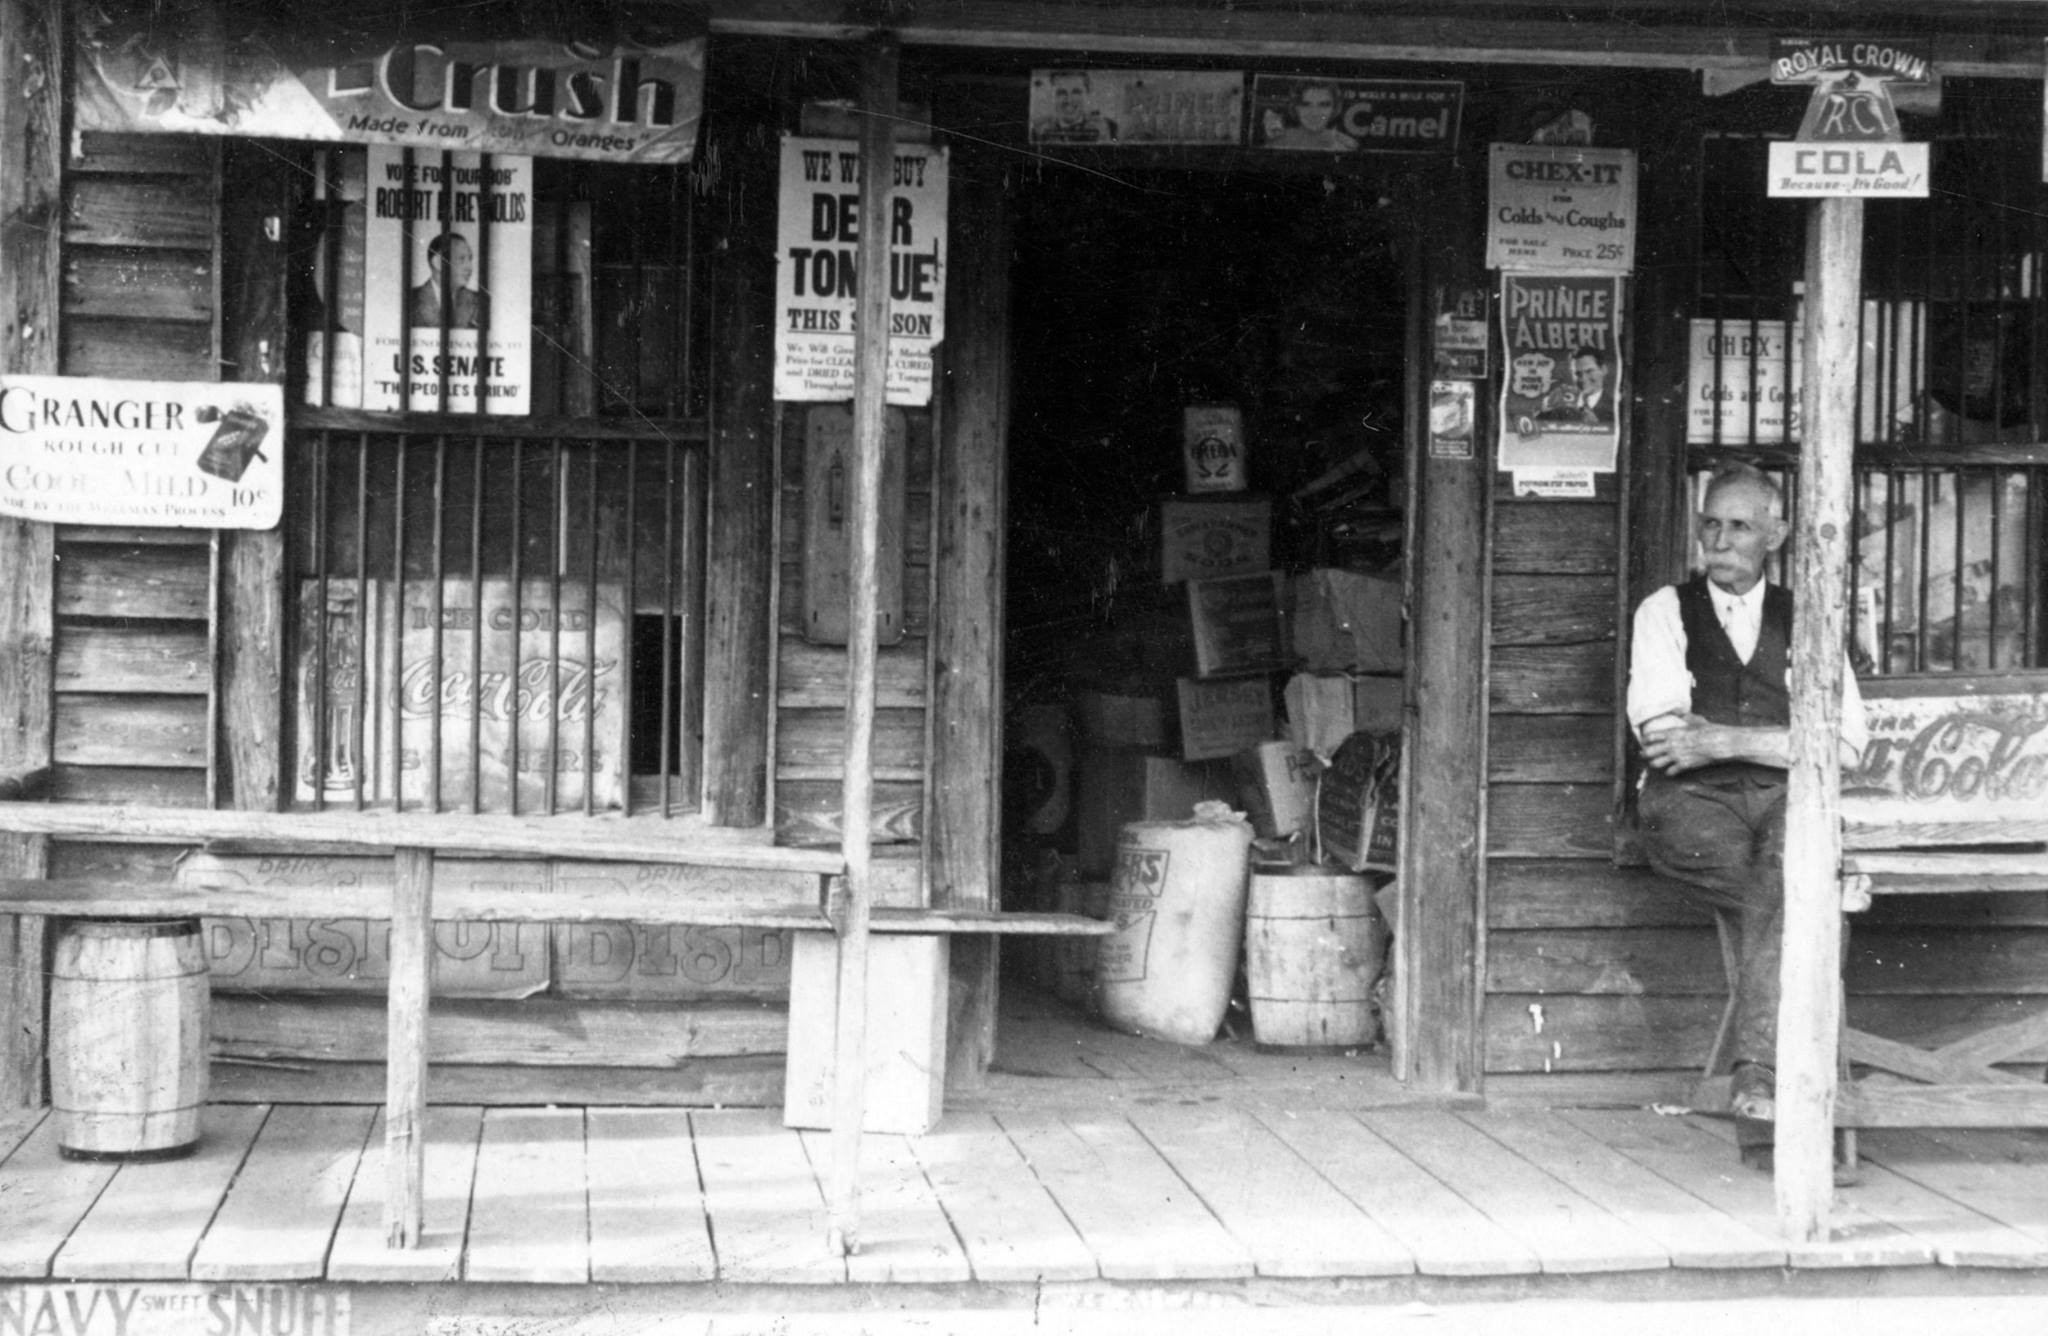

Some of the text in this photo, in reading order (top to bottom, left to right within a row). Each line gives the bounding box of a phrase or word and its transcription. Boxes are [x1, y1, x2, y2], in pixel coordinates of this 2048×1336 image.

[1777, 44, 1926, 79] ROYAL CROWN
[348, 114, 408, 134] Made
[416, 118, 470, 138] from
[1343, 102, 1449, 139] Camel
[386, 164, 419, 183] VOE
[423, 166, 449, 183] FO
[802, 150, 832, 182] WE
[893, 155, 927, 188] BUY
[1505, 160, 1622, 184] CHEX-IT
[1795, 150, 1904, 175] COLA
[376, 187, 433, 220] ROBRT
[455, 191, 526, 222] REOLDS
[812, 192, 913, 246] DER
[1498, 206, 1544, 225] Colds
[1566, 208, 1626, 231] Coughs
[789, 247, 935, 303] TONUE
[787, 308, 933, 335] THIS SON
[1514, 316, 1609, 350] ALBERT
[394, 353, 429, 375] US.
[826, 357, 856, 367] CLEA
[374, 380, 405, 395] "TH
[410, 382, 469, 397] PEOLE'S
[1701, 384, 1734, 402] Cods
[1741, 385, 1763, 402] ad
[0, 386, 184, 433] GRANGER
[44, 439, 179, 456] ROUGH CUT
[123, 469, 209, 498] MILD
[411, 606, 591, 632] ICE COLD
[391, 655, 618, 722] Coca-Cola
[257, 859, 329, 874] DRINK
[637, 866, 706, 882] DRINK
[0, 1286, 350, 1336] NAVY SWEET SNUFF
